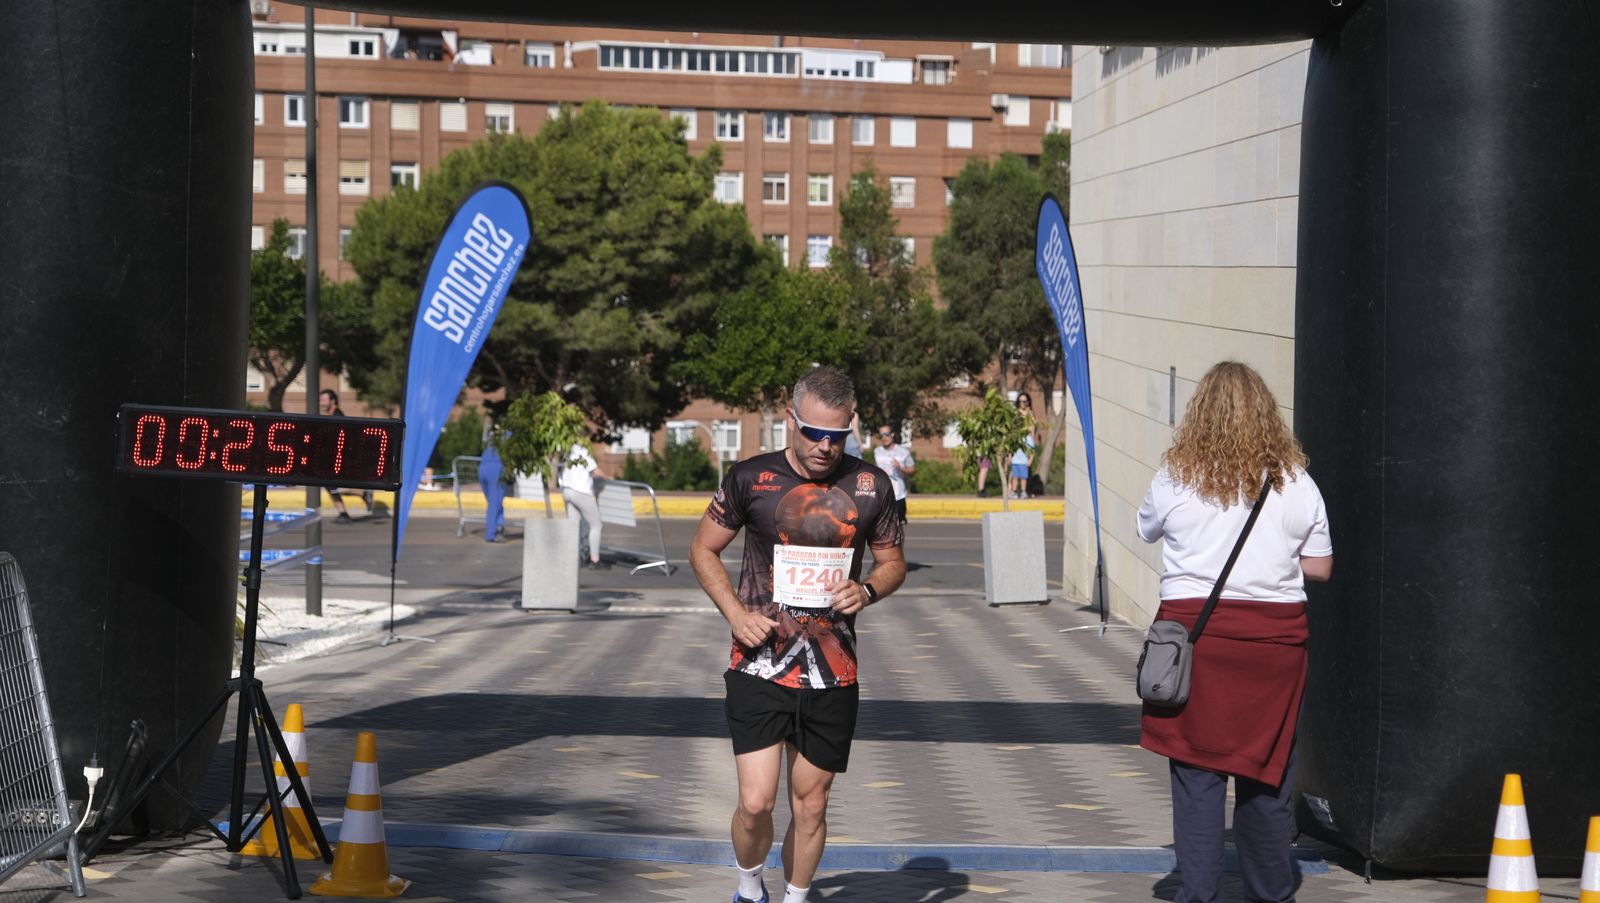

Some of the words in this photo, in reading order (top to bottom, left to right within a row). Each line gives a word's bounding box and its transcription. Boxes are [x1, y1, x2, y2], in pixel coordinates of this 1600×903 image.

[464, 244, 524, 353] centrohogarsanchez.es
[133, 415, 388, 477] 00:25:17
[786, 567, 844, 587] 1240
